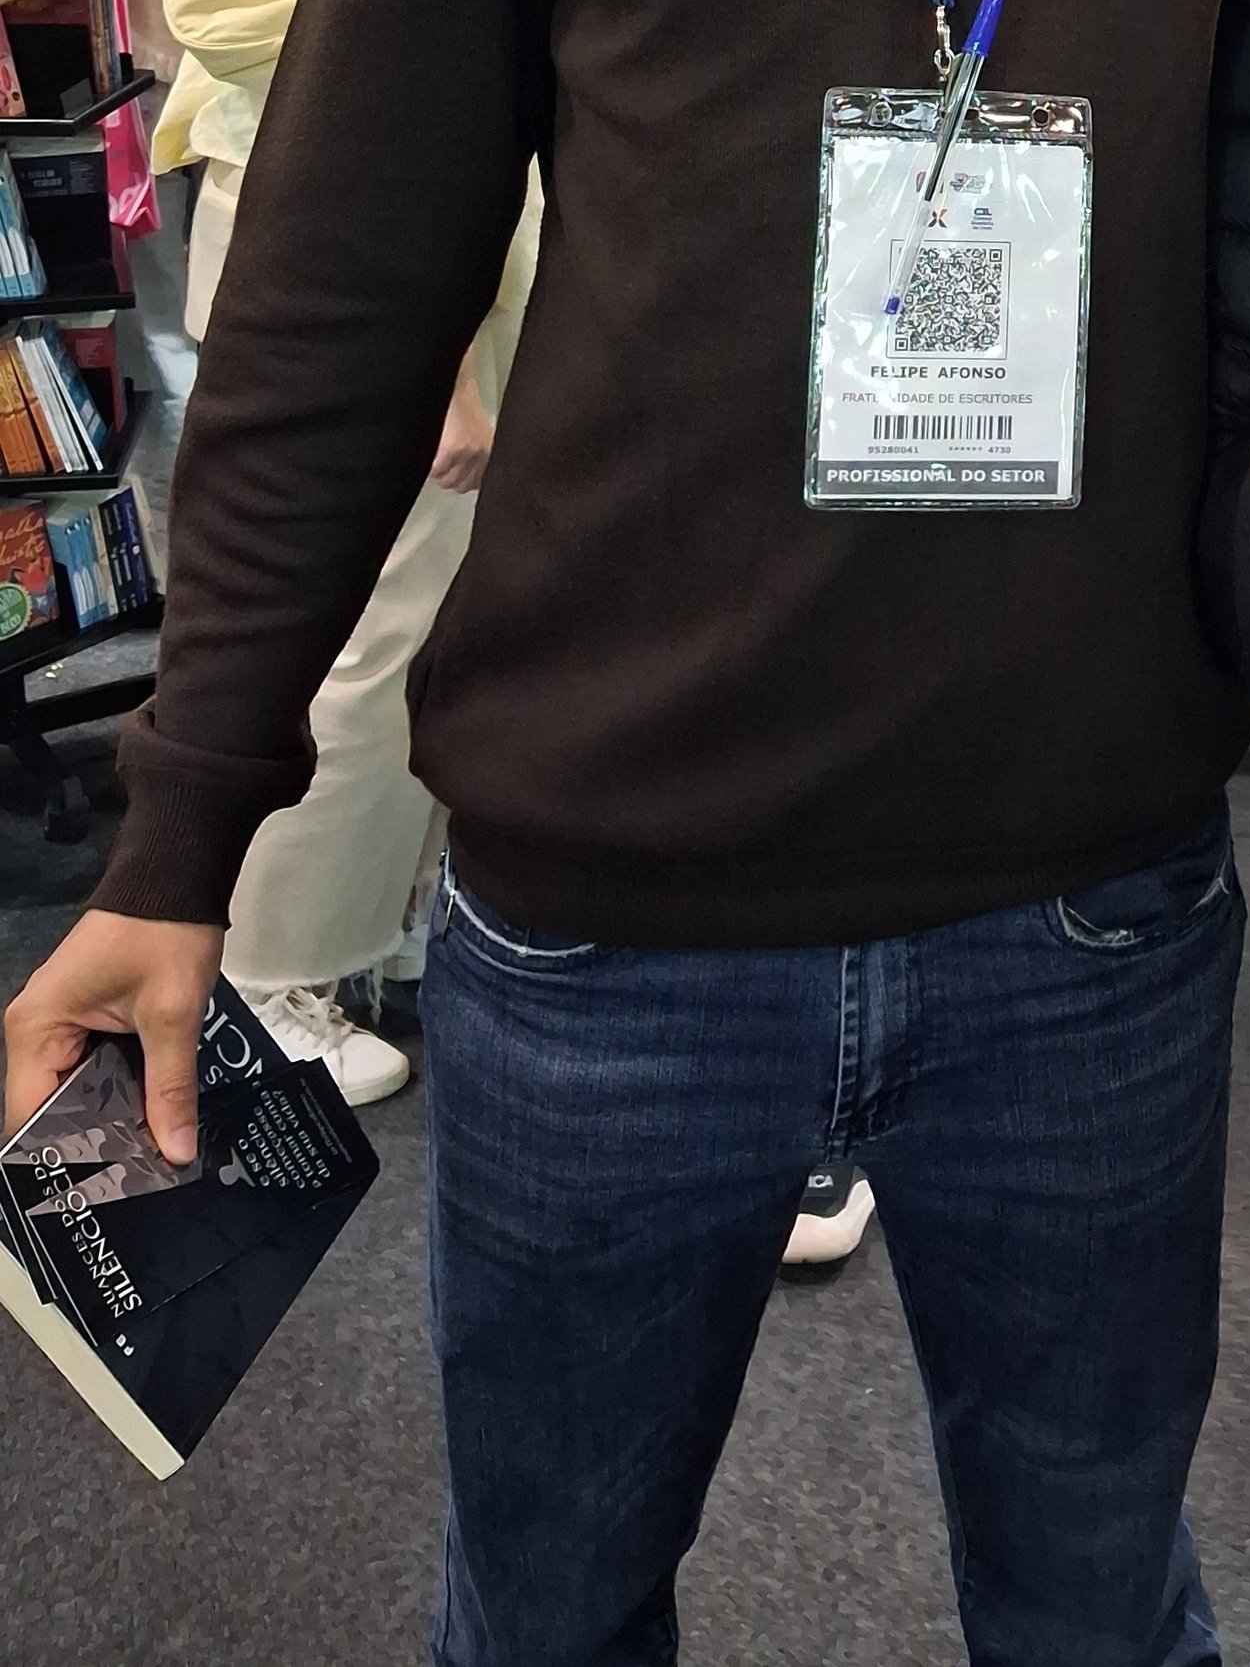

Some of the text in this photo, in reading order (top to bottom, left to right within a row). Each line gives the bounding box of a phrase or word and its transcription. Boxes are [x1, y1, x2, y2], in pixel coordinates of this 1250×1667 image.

[871, 366, 1006, 380] FELIPE AFONSO
[939, 393, 954, 404] DE
[958, 394, 1033, 404] ESCRITORES
[827, 468, 1045, 483] PROFISSIONAL DO SETOR
[55, 1198, 74, 1228] DO
[67, 1191, 144, 1312] SILÊNCIO
[72, 1232, 125, 1319] NUANCES
